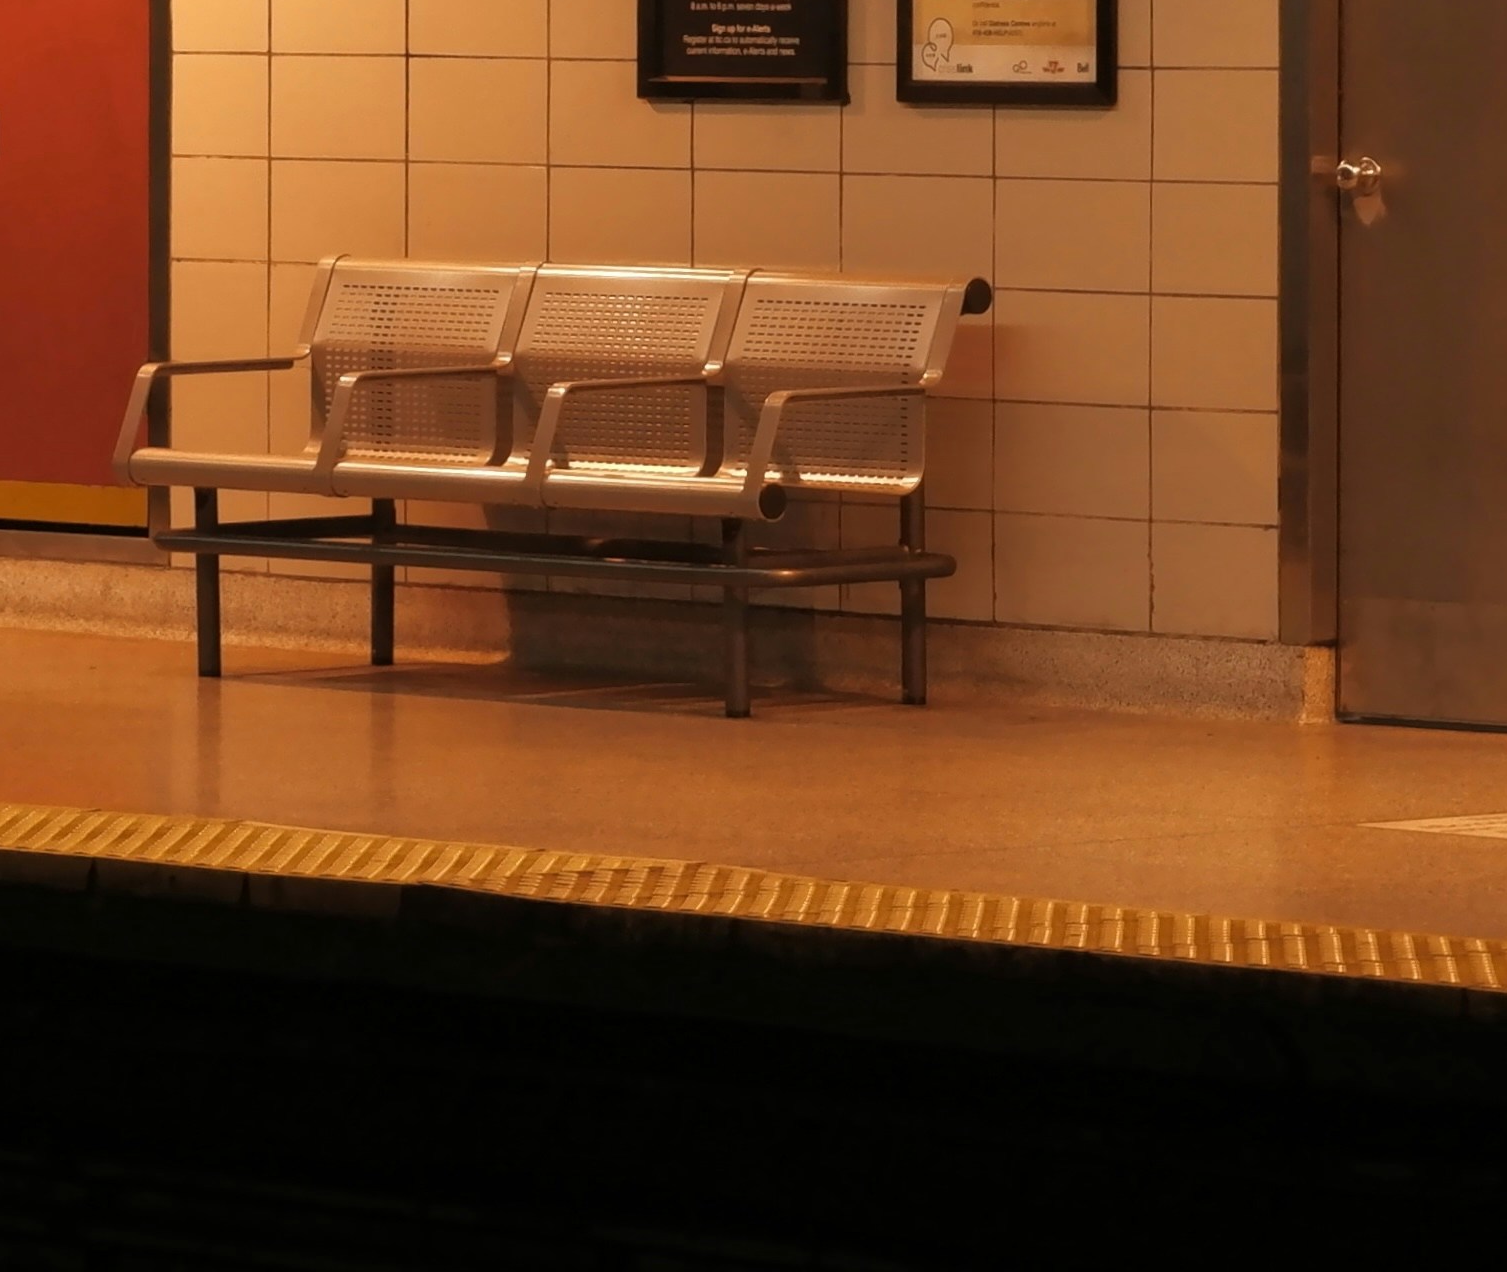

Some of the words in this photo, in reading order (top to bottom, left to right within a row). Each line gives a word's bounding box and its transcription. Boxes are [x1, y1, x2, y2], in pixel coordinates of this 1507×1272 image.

[711, 24, 726, 34] Sign
[726, 25, 735, 34] up
[736, 24, 745, 33] for
